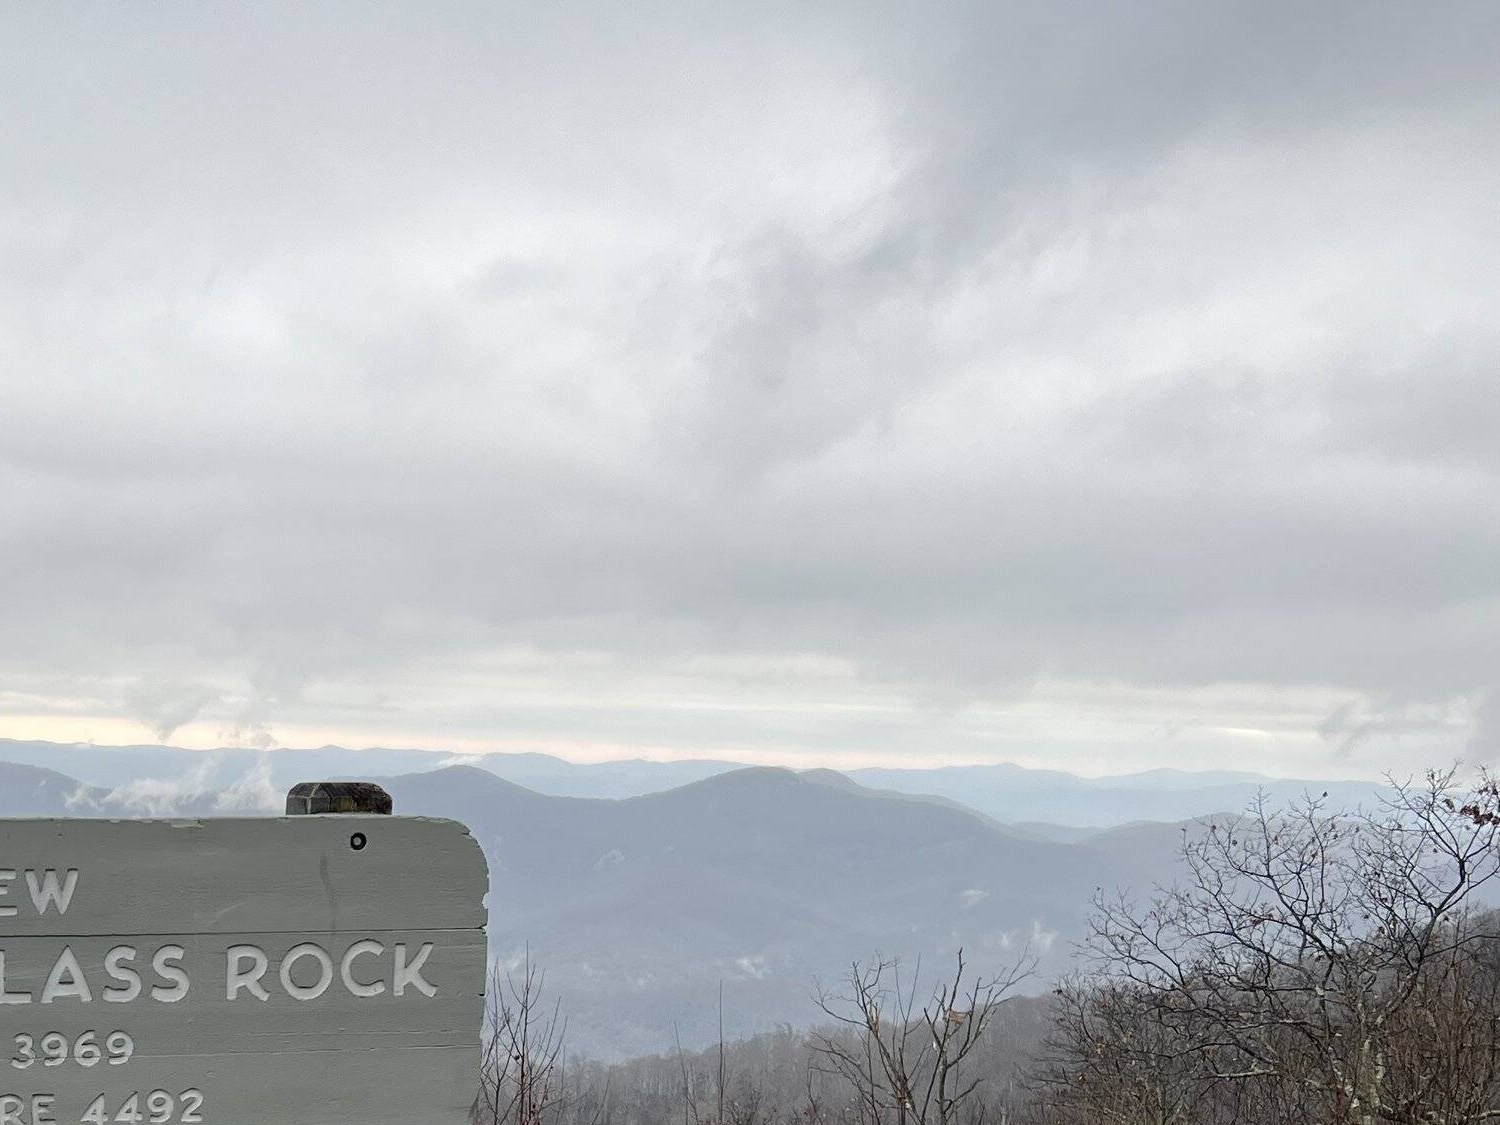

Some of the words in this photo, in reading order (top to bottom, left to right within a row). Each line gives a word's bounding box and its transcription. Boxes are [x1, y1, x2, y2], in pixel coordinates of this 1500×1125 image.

[226, 938, 438, 1002] ROCK
[10, 1030, 135, 1069] 3969
[79, 1087, 204, 1125] 4492
